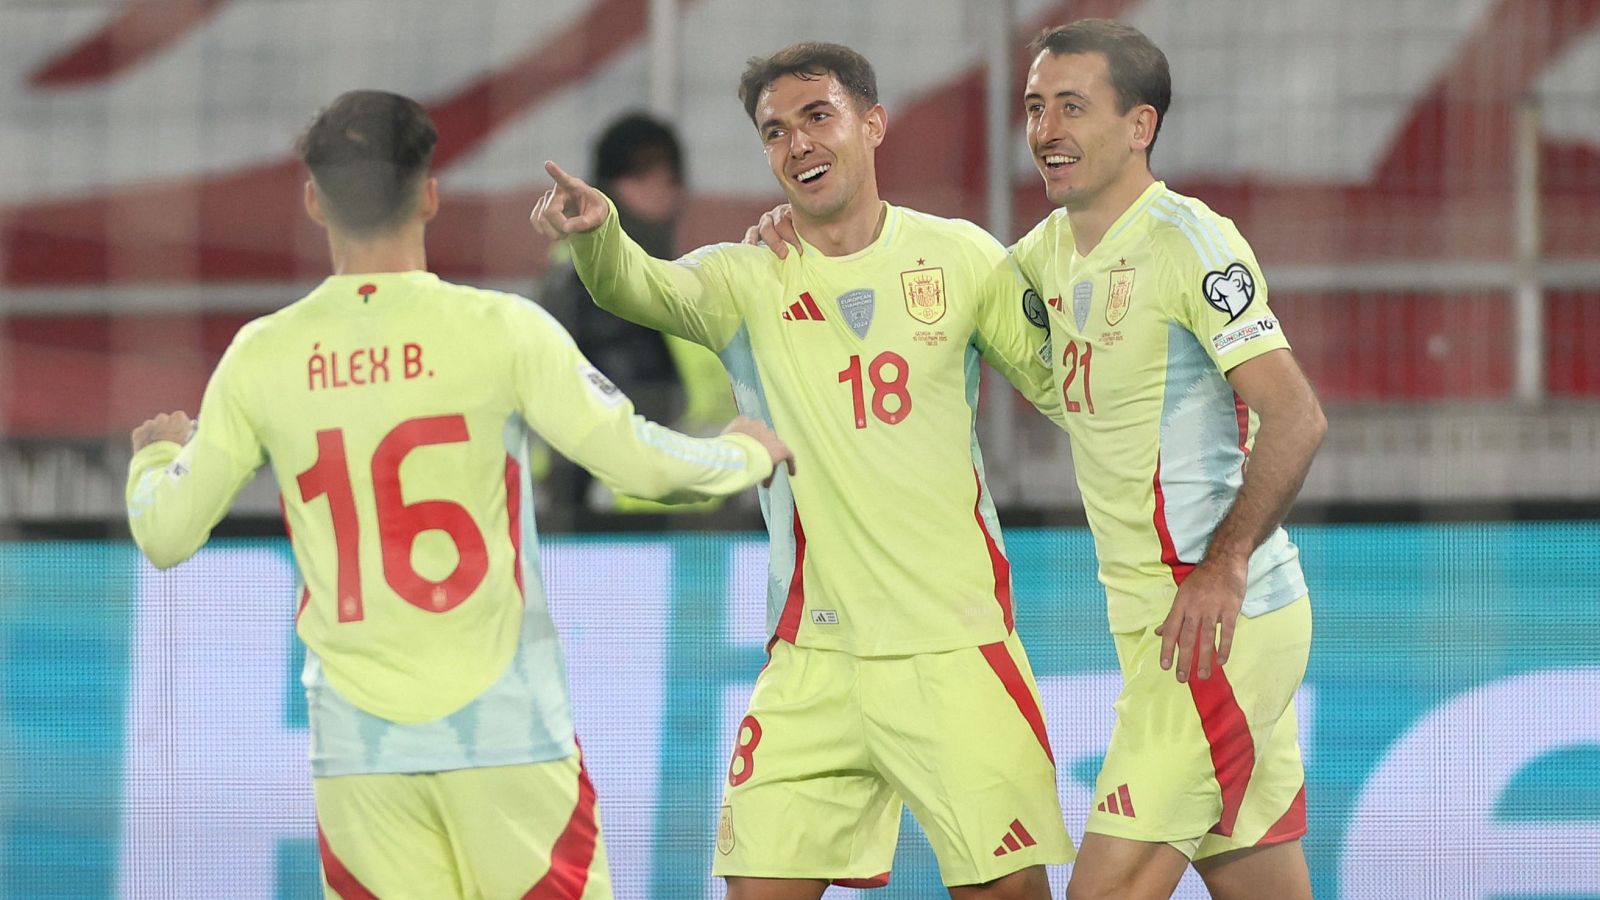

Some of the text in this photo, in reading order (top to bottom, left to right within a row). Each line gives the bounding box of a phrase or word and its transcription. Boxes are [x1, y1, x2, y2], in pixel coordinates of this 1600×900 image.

[308, 342, 434, 391] ÁLEX B.
[1214, 325, 1258, 348] FOUNDATION
[838, 350, 912, 430] 18
[1062, 340, 1095, 415] 21
[296, 413, 489, 624] 16
